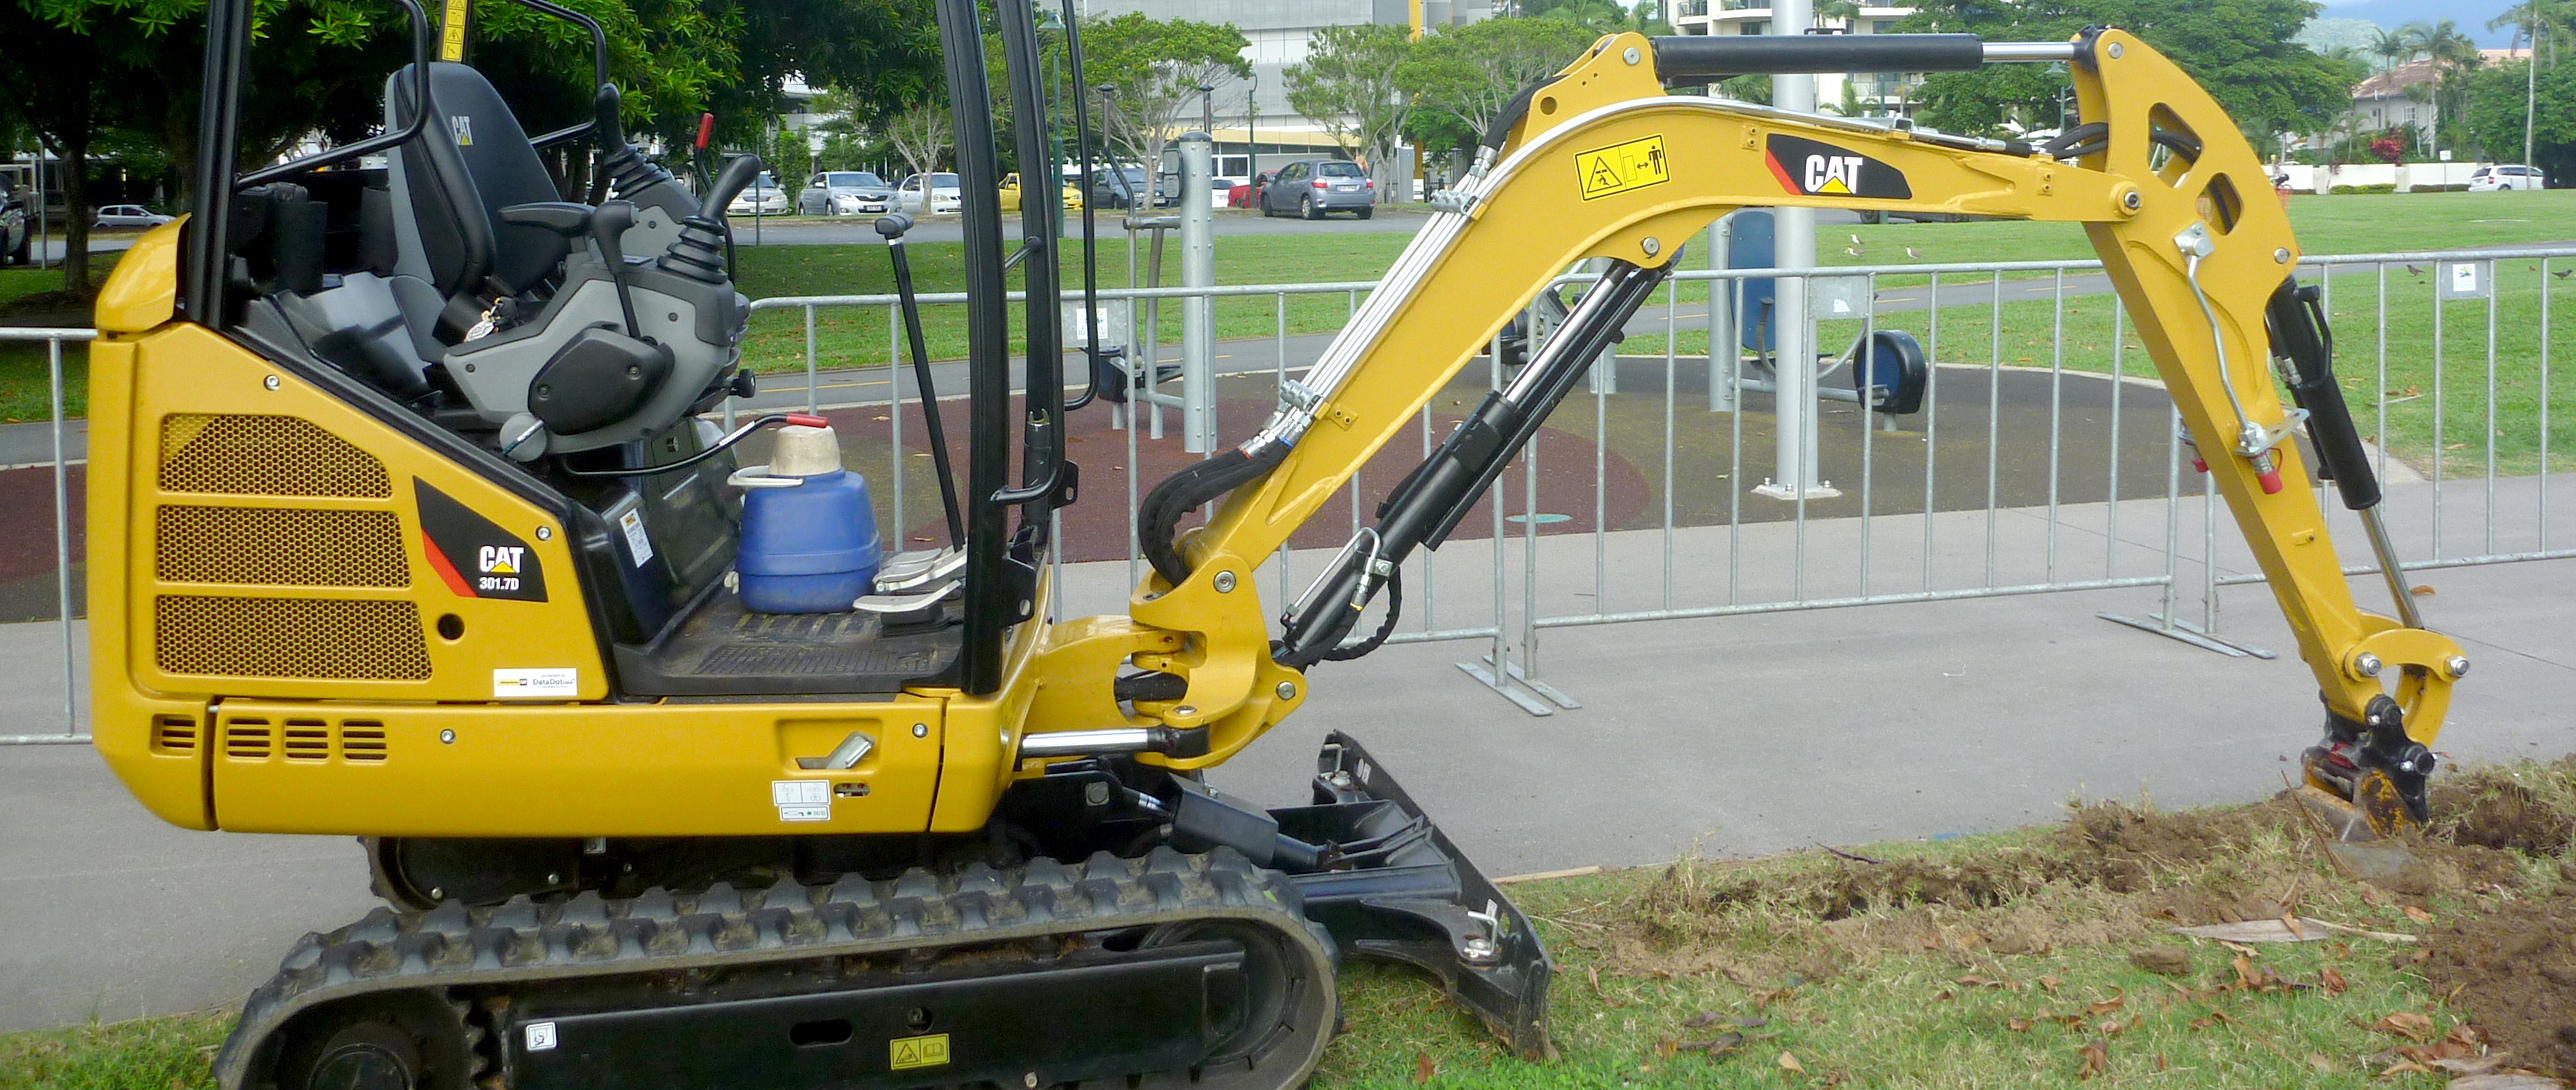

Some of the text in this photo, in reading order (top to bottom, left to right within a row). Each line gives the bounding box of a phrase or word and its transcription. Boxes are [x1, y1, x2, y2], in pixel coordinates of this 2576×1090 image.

[452, 115, 473, 146] CAT
[1804, 154, 1863, 195] CAT
[479, 545, 524, 574] CAT
[479, 576, 519, 590] 301.7D
